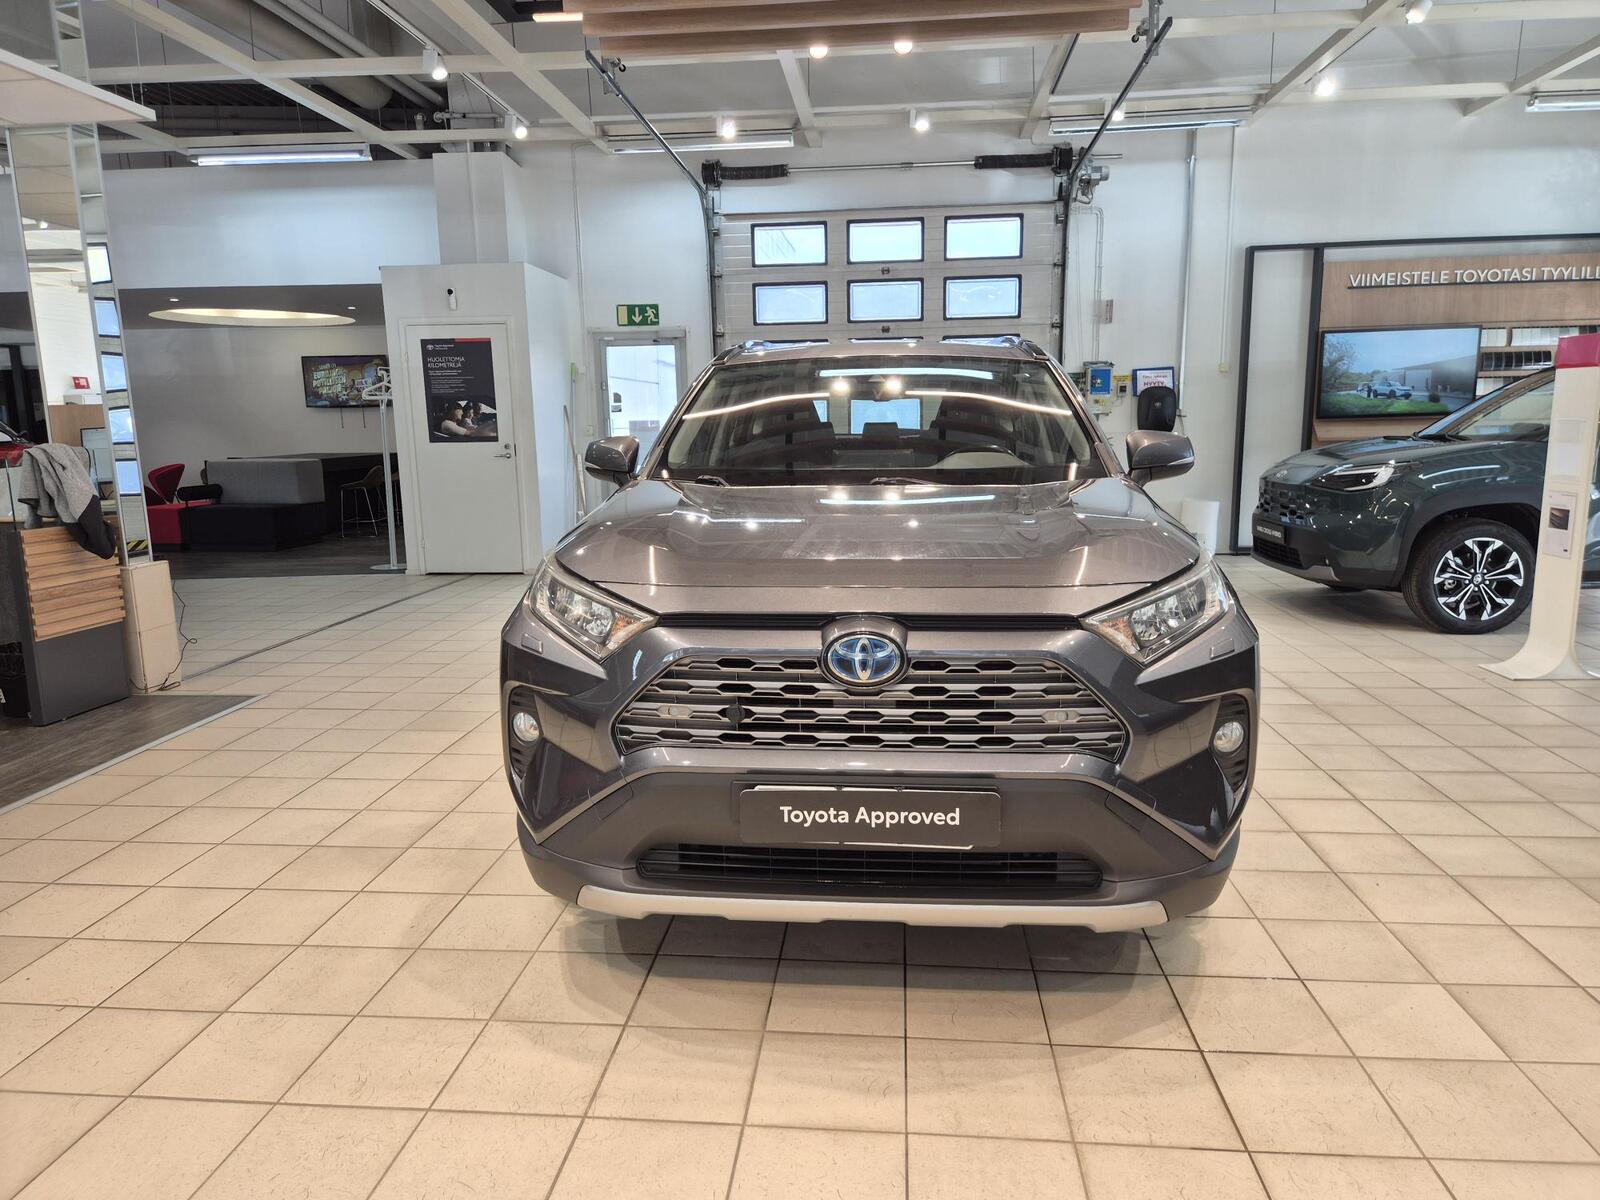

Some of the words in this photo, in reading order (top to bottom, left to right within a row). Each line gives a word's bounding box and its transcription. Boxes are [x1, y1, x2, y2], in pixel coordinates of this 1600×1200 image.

[1350, 270, 1449, 287] VIIMEISTELE
[1454, 267, 1536, 283] TOYOTASI
[779, 806, 849, 827] Toyota
[855, 806, 960, 828] Approved
